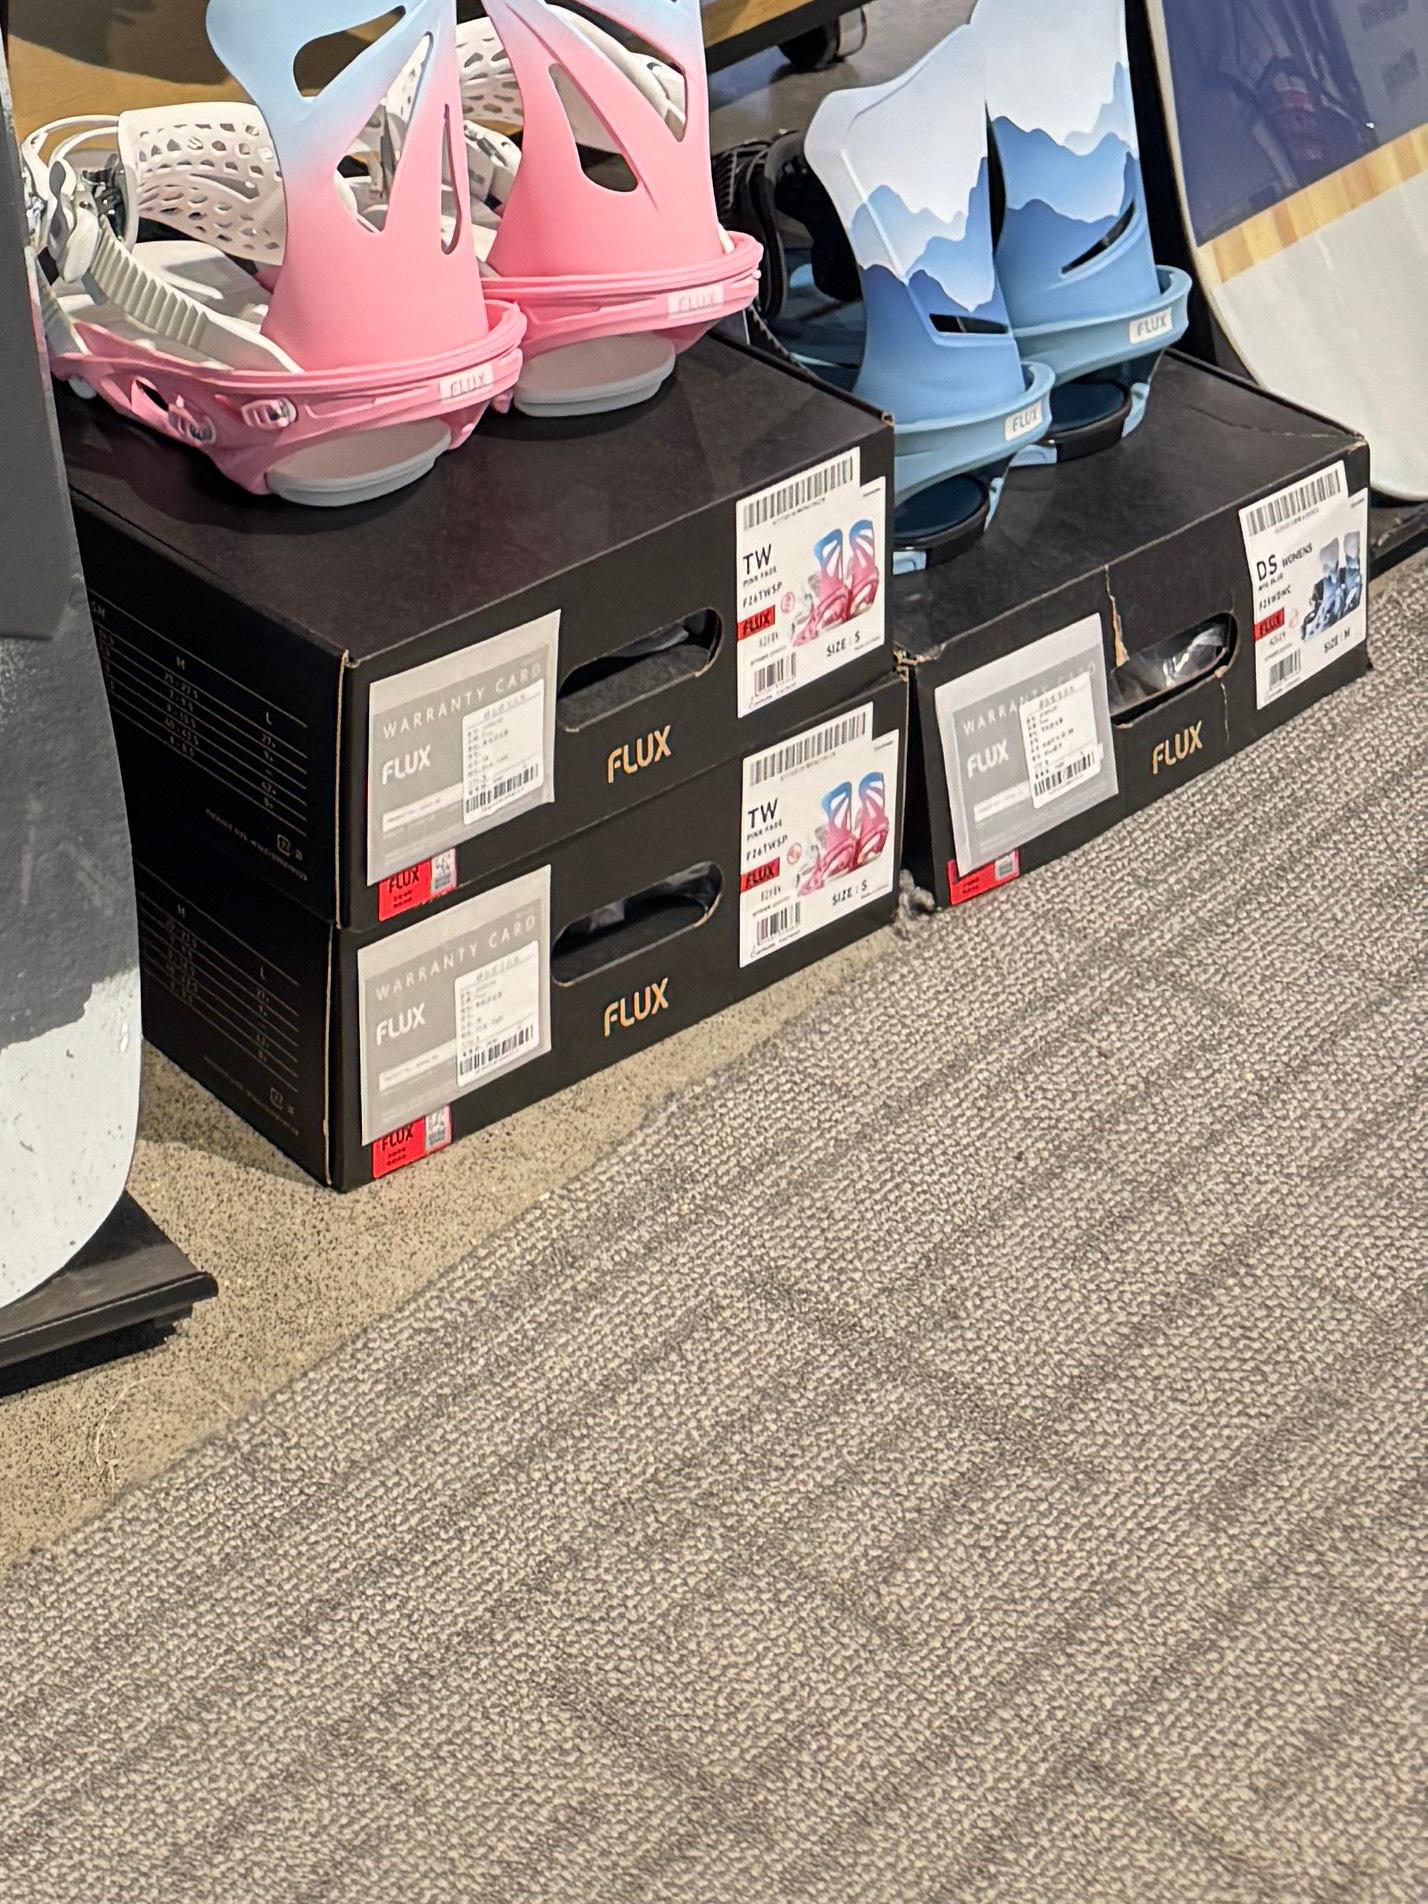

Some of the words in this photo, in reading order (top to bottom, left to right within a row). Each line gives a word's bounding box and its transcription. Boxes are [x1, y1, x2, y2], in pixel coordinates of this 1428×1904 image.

[1137, 315, 1167, 336] FLUX
[1012, 405, 1041, 432] FLUX
[743, 543, 772, 576] TW
[1256, 553, 1278, 581] DS
[743, 611, 772, 635] FLUX
[826, 637, 846, 657] SIZE
[383, 686, 485, 740] WARRANTY
[495, 661, 542, 693] CARD
[382, 744, 432, 786] FLUX
[606, 725, 671, 785] FLUX
[967, 739, 1010, 780] FLUX
[1151, 720, 1204, 775] FLUX
[747, 797, 778, 829] TW
[832, 886, 853, 906] SIZE
[375, 943, 479, 1001] WARRANTY
[489, 915, 536, 949] CARD
[376, 1003, 427, 1046] FLUX
[603, 977, 670, 1038] FLUX
